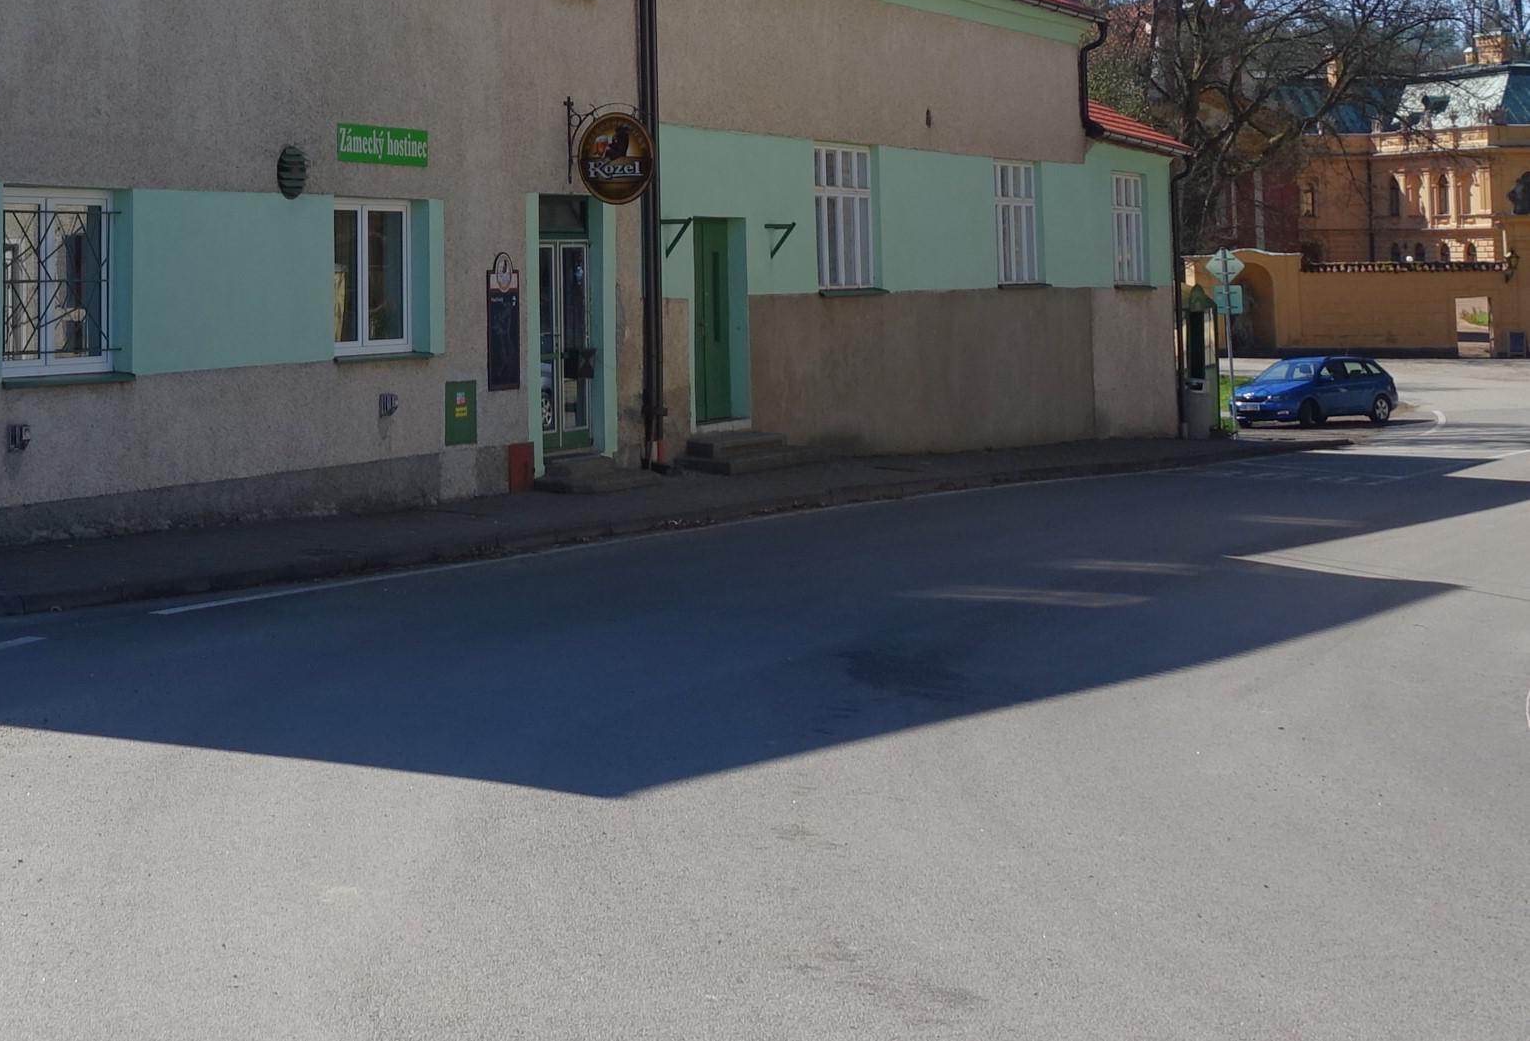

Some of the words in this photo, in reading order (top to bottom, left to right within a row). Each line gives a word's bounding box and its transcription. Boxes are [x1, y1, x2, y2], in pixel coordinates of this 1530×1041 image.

[339, 127, 385, 160] Zámecký
[387, 131, 428, 158] hostinec
[588, 160, 643, 180] Kozel
